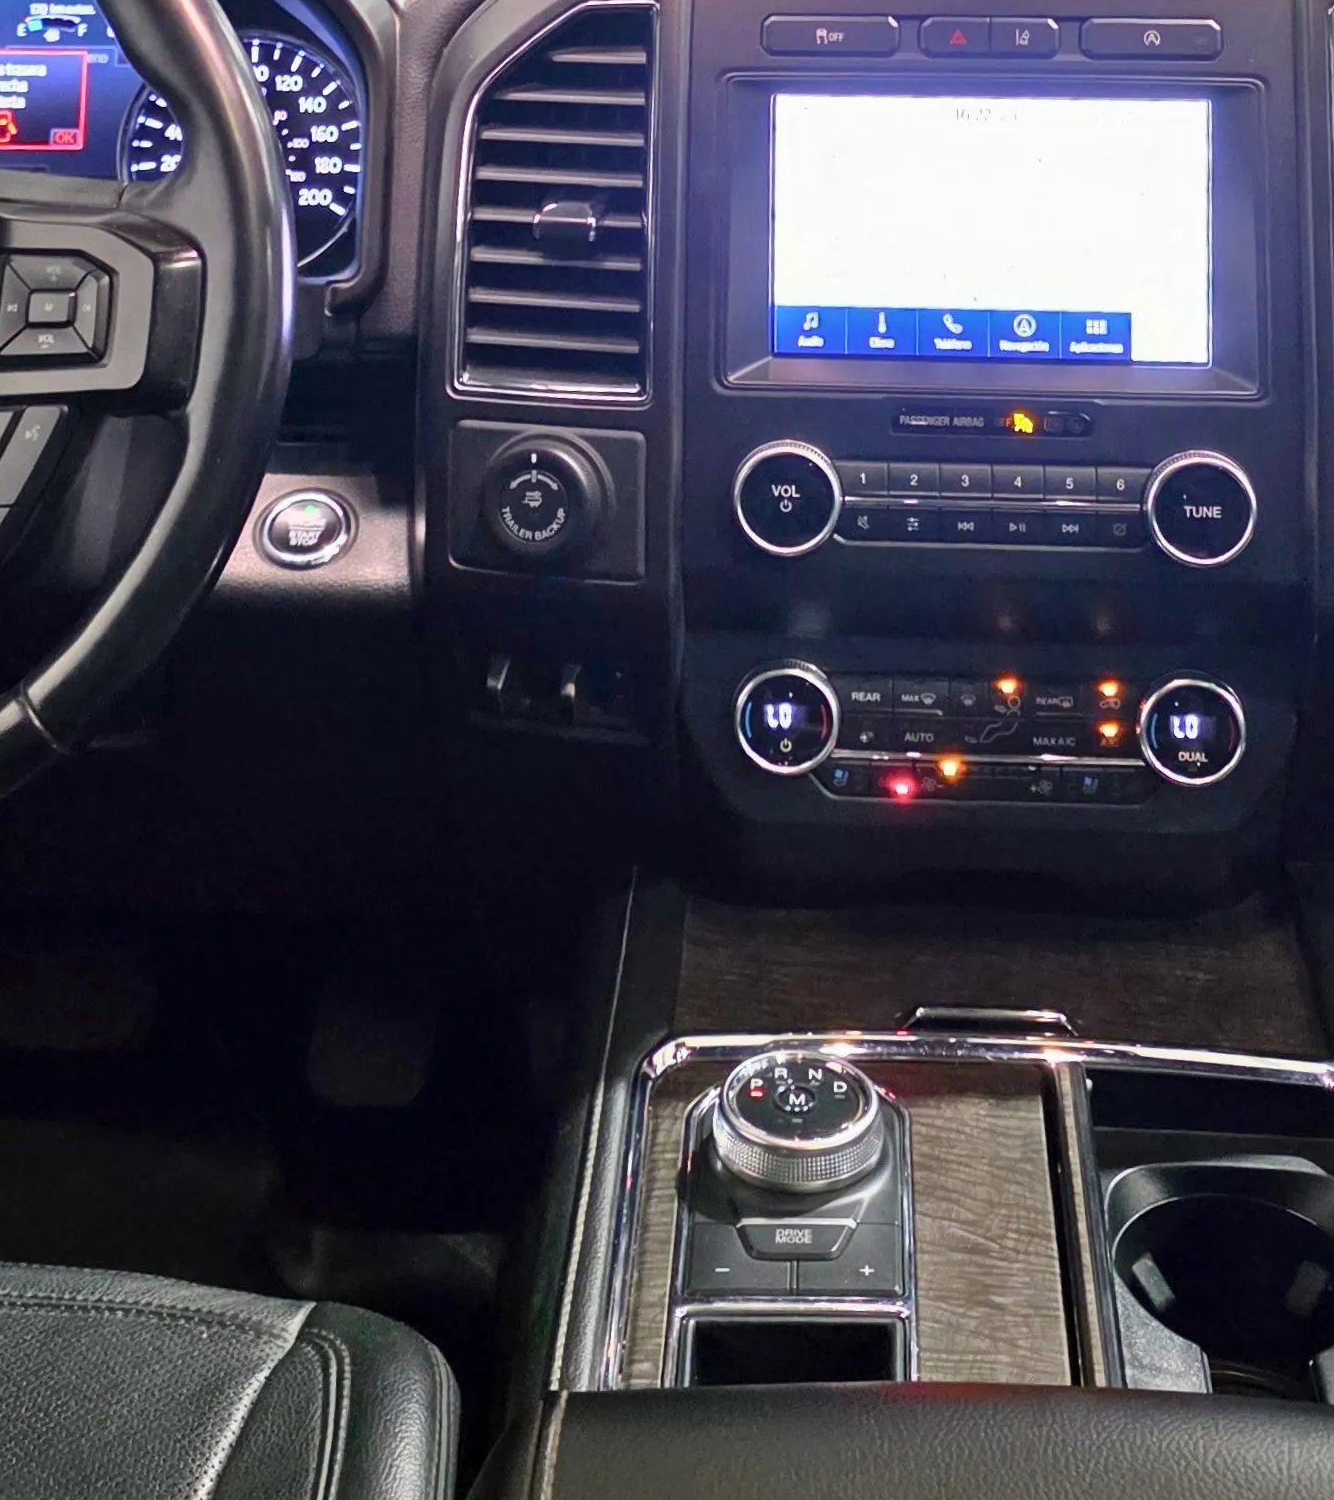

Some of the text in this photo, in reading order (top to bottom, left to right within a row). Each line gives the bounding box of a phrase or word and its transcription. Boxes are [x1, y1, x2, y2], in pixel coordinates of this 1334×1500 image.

[17, 23, 27, 37] E
[77, 23, 88, 37] F
[828, 32, 844, 42] OFF
[275, 74, 303, 92] 120
[298, 96, 327, 113] 140
[54, 132, 75, 145] OK
[310, 125, 339, 142] 160
[314, 156, 342, 174] 180
[298, 188, 332, 206] 200
[900, 415, 949, 426] PASSENGER
[952, 415, 985, 427] AIRBAG
[860, 473, 866, 485] 1
[909, 474, 919, 486] 2
[961, 474, 970, 487] 3
[1013, 476, 1023, 488] 4
[1065, 477, 1074, 490] 5
[1116, 479, 1125, 491] 6
[771, 484, 801, 499] VOL
[1184, 505, 1222, 519] TUNE
[502, 506, 565, 541] TRAILER BACKUP
[851, 692, 881, 702] REAR
[904, 732, 935, 743] AUTO
[1033, 737, 1076, 748] MAX A/C
[1178, 752, 1208, 763] DUAL
[774, 1068, 788, 1079] R
[808, 1069, 822, 1080] N
[750, 1079, 764, 1089] P
[833, 1081, 847, 1093] D
[789, 1094, 806, 1106] M
[775, 1228, 813, 1237] DRIVE
[775, 1236, 813, 1244] MODE
